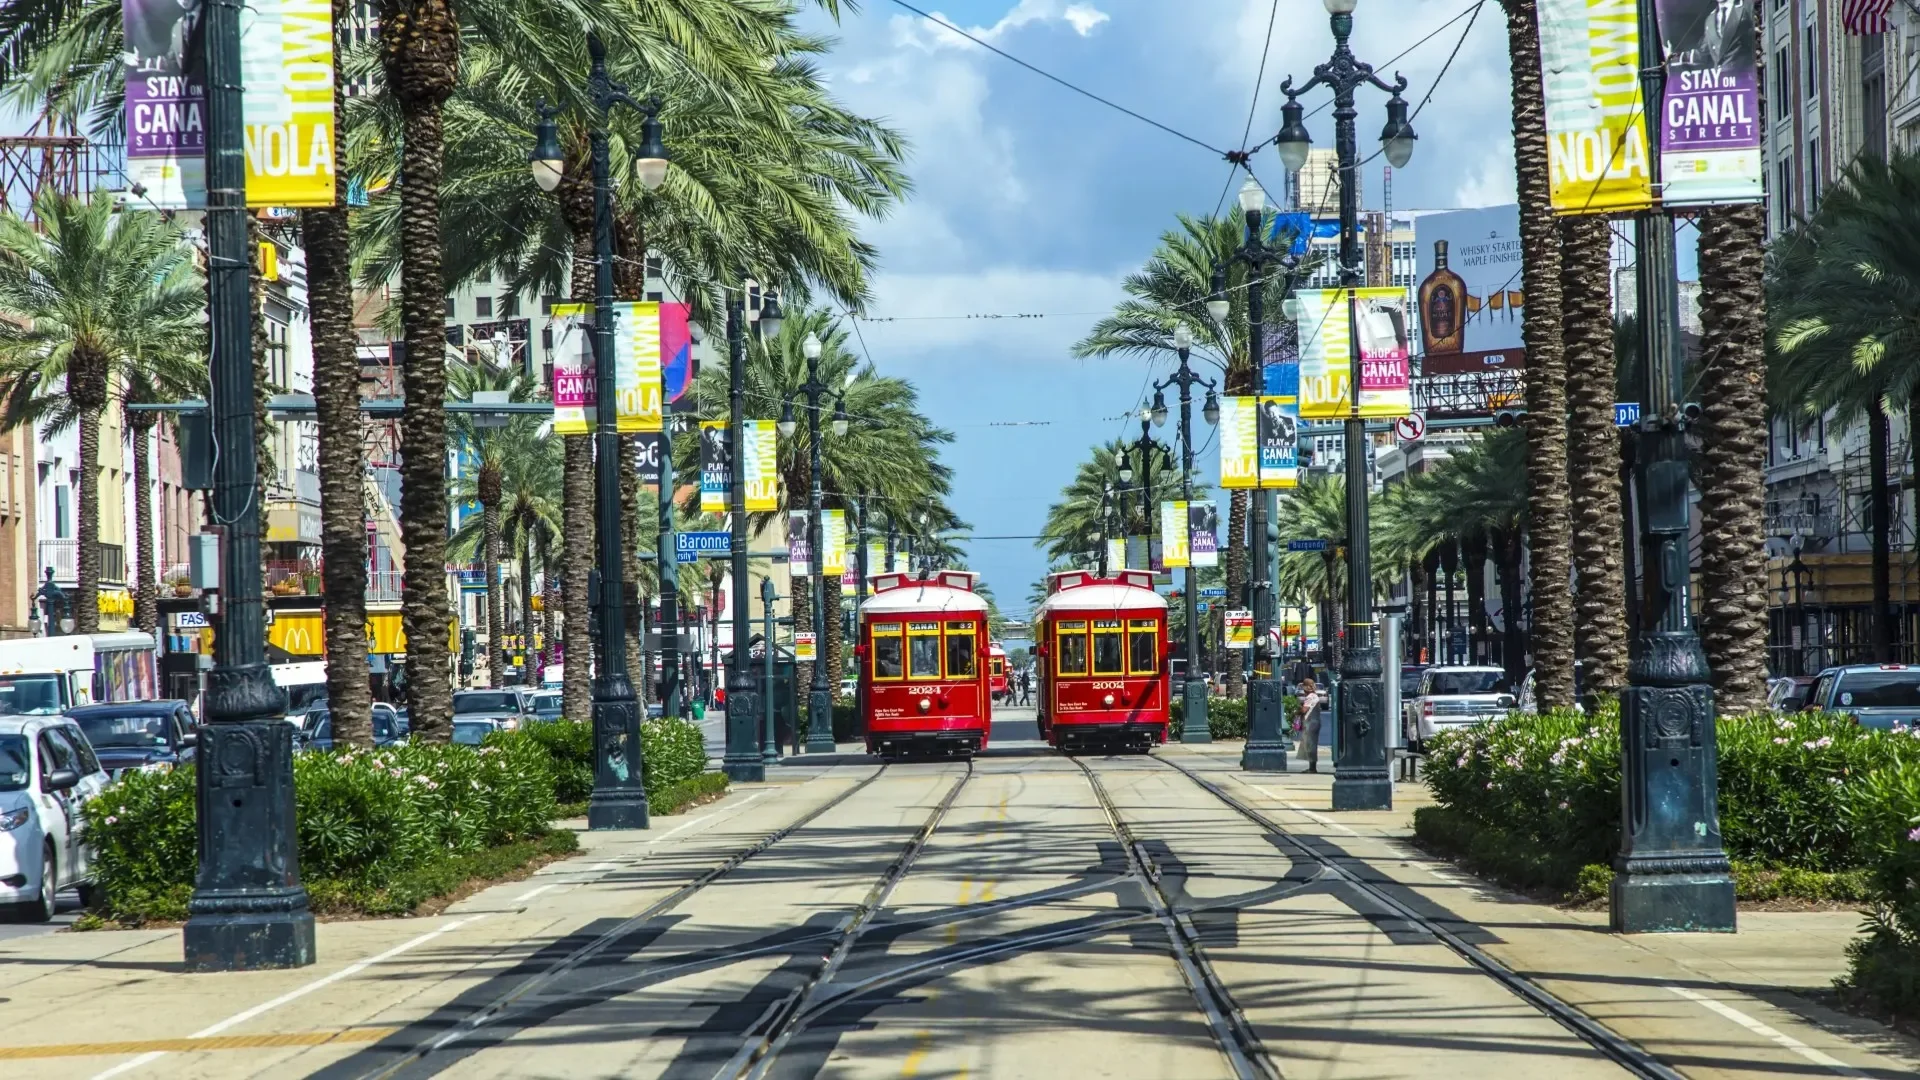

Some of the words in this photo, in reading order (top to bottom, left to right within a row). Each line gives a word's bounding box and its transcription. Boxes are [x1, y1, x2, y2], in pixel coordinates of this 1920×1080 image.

[147, 76, 188, 97] STAY
[190, 85, 203, 97] ON
[1680, 67, 1721, 91] STAY
[1723, 76, 1736, 88] ON
[1668, 94, 1752, 128] CANAL
[134, 104, 203, 134] CANA
[136, 133, 203, 146] STREE
[1669, 125, 1753, 140] STREET
[244, 123, 335, 177] NOLA
[1550, 125, 1649, 185] NOLA
[1460, 244, 1491, 256] WHISKY
[1492, 241, 1520, 252] STARTE
[1464, 255, 1487, 267] MAPLE
[1490, 252, 1522, 264] FINISHED
[1366, 348, 1390, 359] SHOP
[562, 364, 588, 376] SHOP
[1362, 361, 1404, 378] CANAL
[1300, 374, 1350, 405] NOLA
[616, 388, 663, 416] NOLA
[1619, 405, 1640, 424] phi
[1267, 438, 1284, 447] PLAY
[1263, 448, 1295, 460] CANAL
[707, 462, 724, 471] PLAY
[1221, 455, 1257, 478] NOLA
[744, 479, 777, 500] NOLA
[679, 534, 729, 549] Baronne
[1192, 538, 1215, 547] CANAL
[1292, 540, 1325, 551] Burgundy
[677, 551, 692, 561] rsity
[181, 613, 206, 626] FAS
[908, 686, 942, 695] 2024
[1092, 681, 1125, 690] 2002
